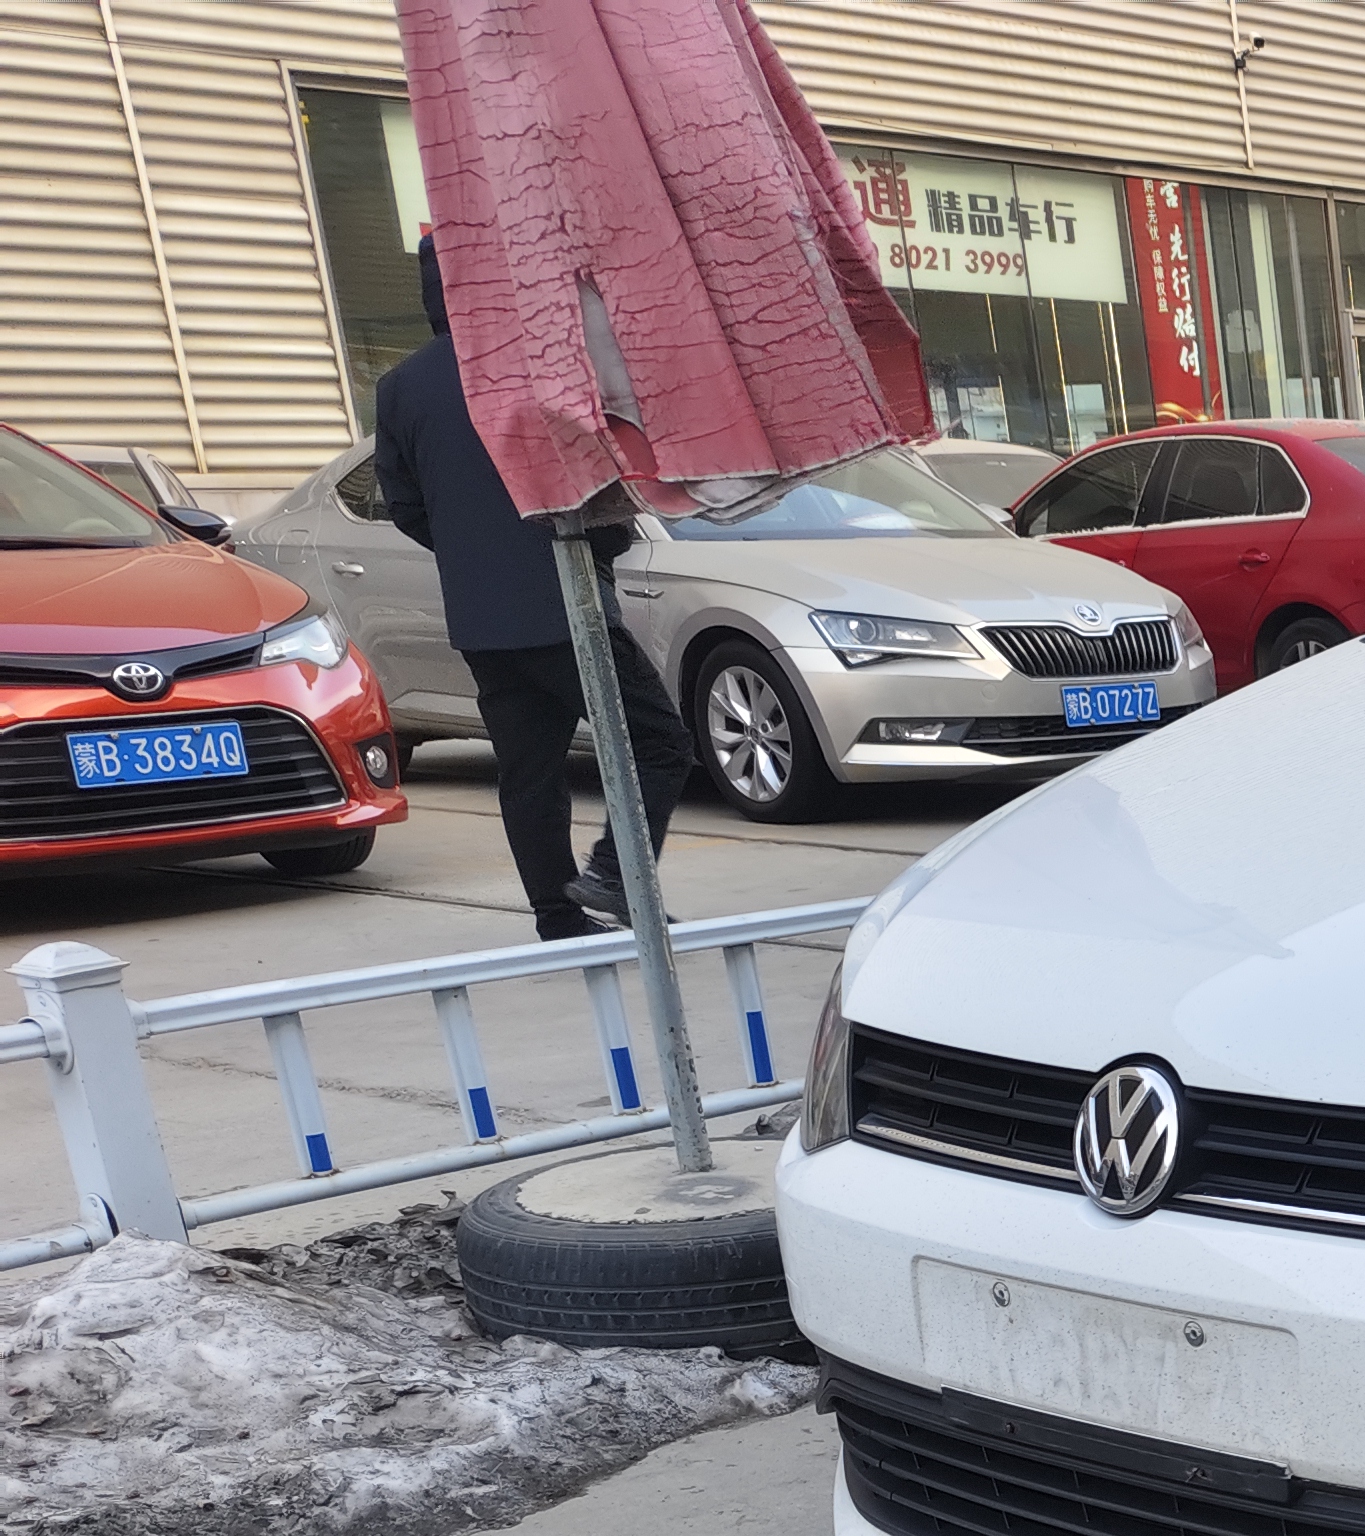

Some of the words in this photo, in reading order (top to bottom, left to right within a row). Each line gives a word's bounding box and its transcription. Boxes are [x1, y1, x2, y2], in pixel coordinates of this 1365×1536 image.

[925, 188, 1078, 245] 精品车行
[889, 243, 952, 272] 8021
[964, 249, 1026, 278] 3999
[1169, 223, 1201, 378] 先行赔付
